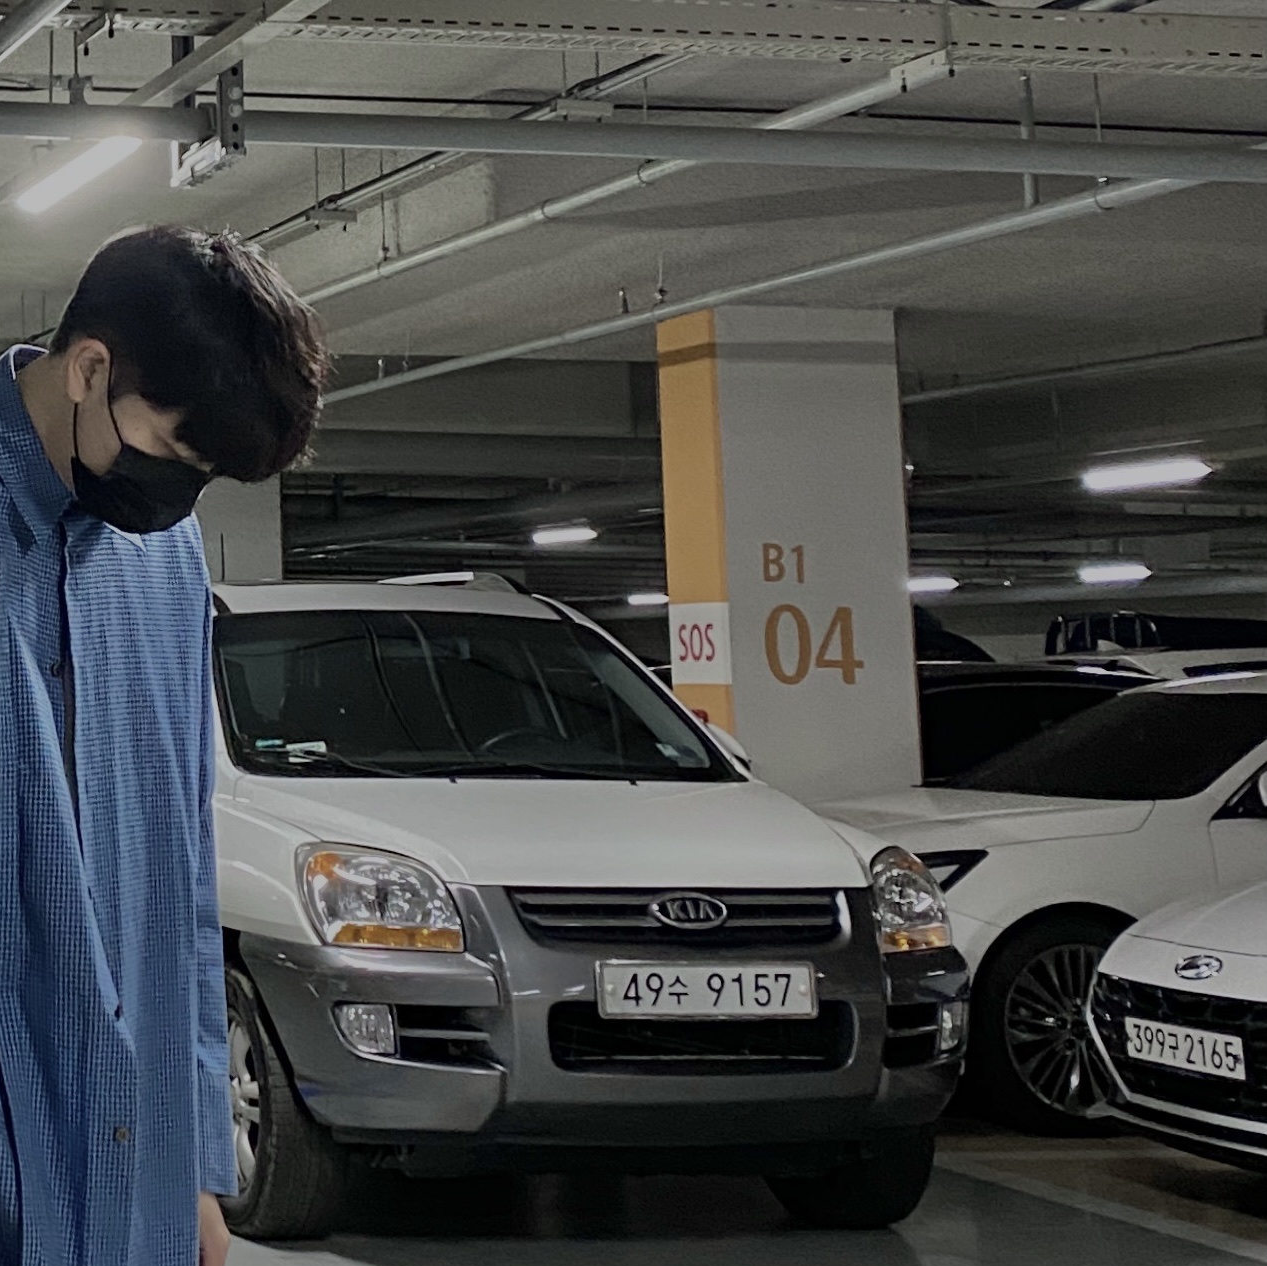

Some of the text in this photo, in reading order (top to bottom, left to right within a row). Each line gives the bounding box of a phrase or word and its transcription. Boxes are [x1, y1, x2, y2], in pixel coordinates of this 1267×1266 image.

[762, 543, 805, 584] B1
[678, 623, 716, 662] SOS
[764, 604, 865, 685] 04
[665, 901, 717, 920] KIA
[623, 973, 791, 1007] 49수 9157
